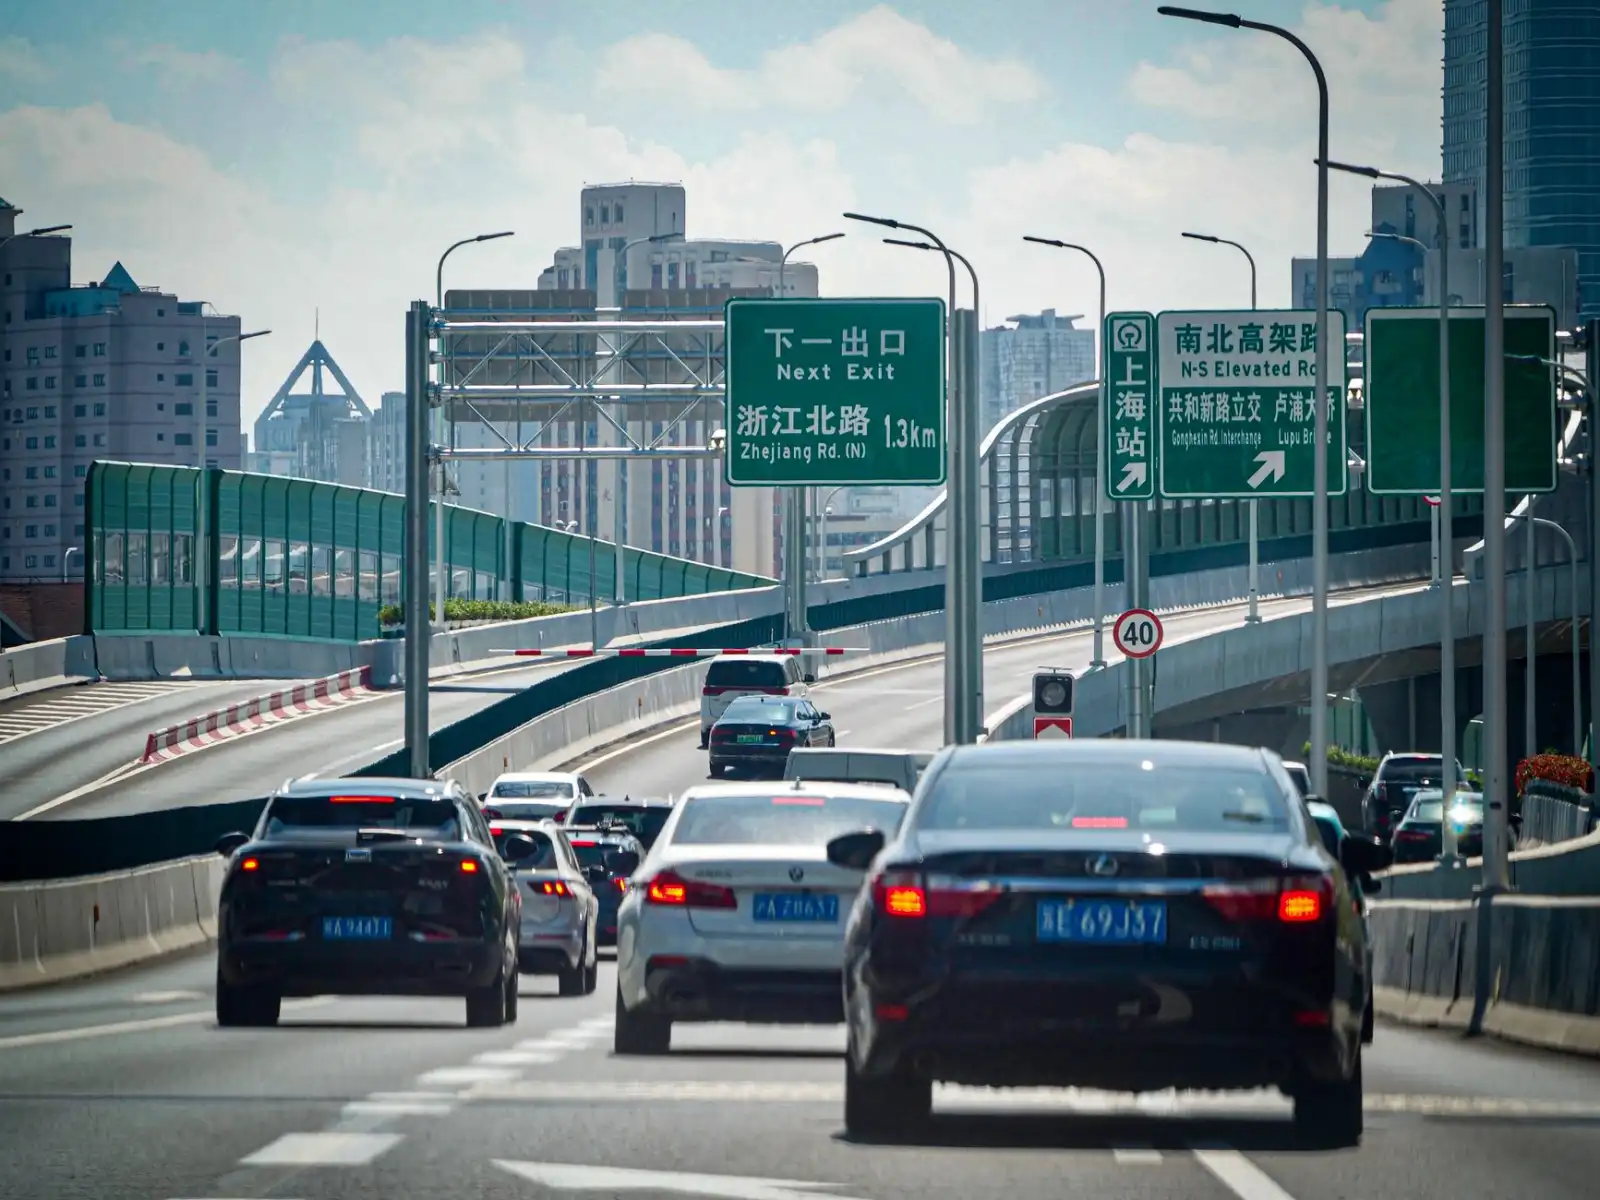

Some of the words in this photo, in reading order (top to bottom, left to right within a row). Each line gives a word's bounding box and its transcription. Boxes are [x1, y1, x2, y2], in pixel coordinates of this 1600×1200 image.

[764, 326, 905, 357] 下一出口
[777, 364, 831, 380] Next
[847, 364, 895, 380] Exit
[1181, 360, 1209, 378] N-S
[1214, 360, 1291, 377] Elevated
[736, 404, 871, 436] 浙江北路
[1115, 357, 1147, 457] 上海站
[1168, 391, 1262, 423] 共和新路立交
[884, 414, 936, 449] 1.3km
[1278, 428, 1300, 447] Lupu
[1303, 428, 1333, 445] Brie
[740, 442, 812, 464] Zhejiang
[817, 443, 841, 459] Rd.
[845, 442, 866, 459] (N)
[1123, 621, 1153, 645] 40
